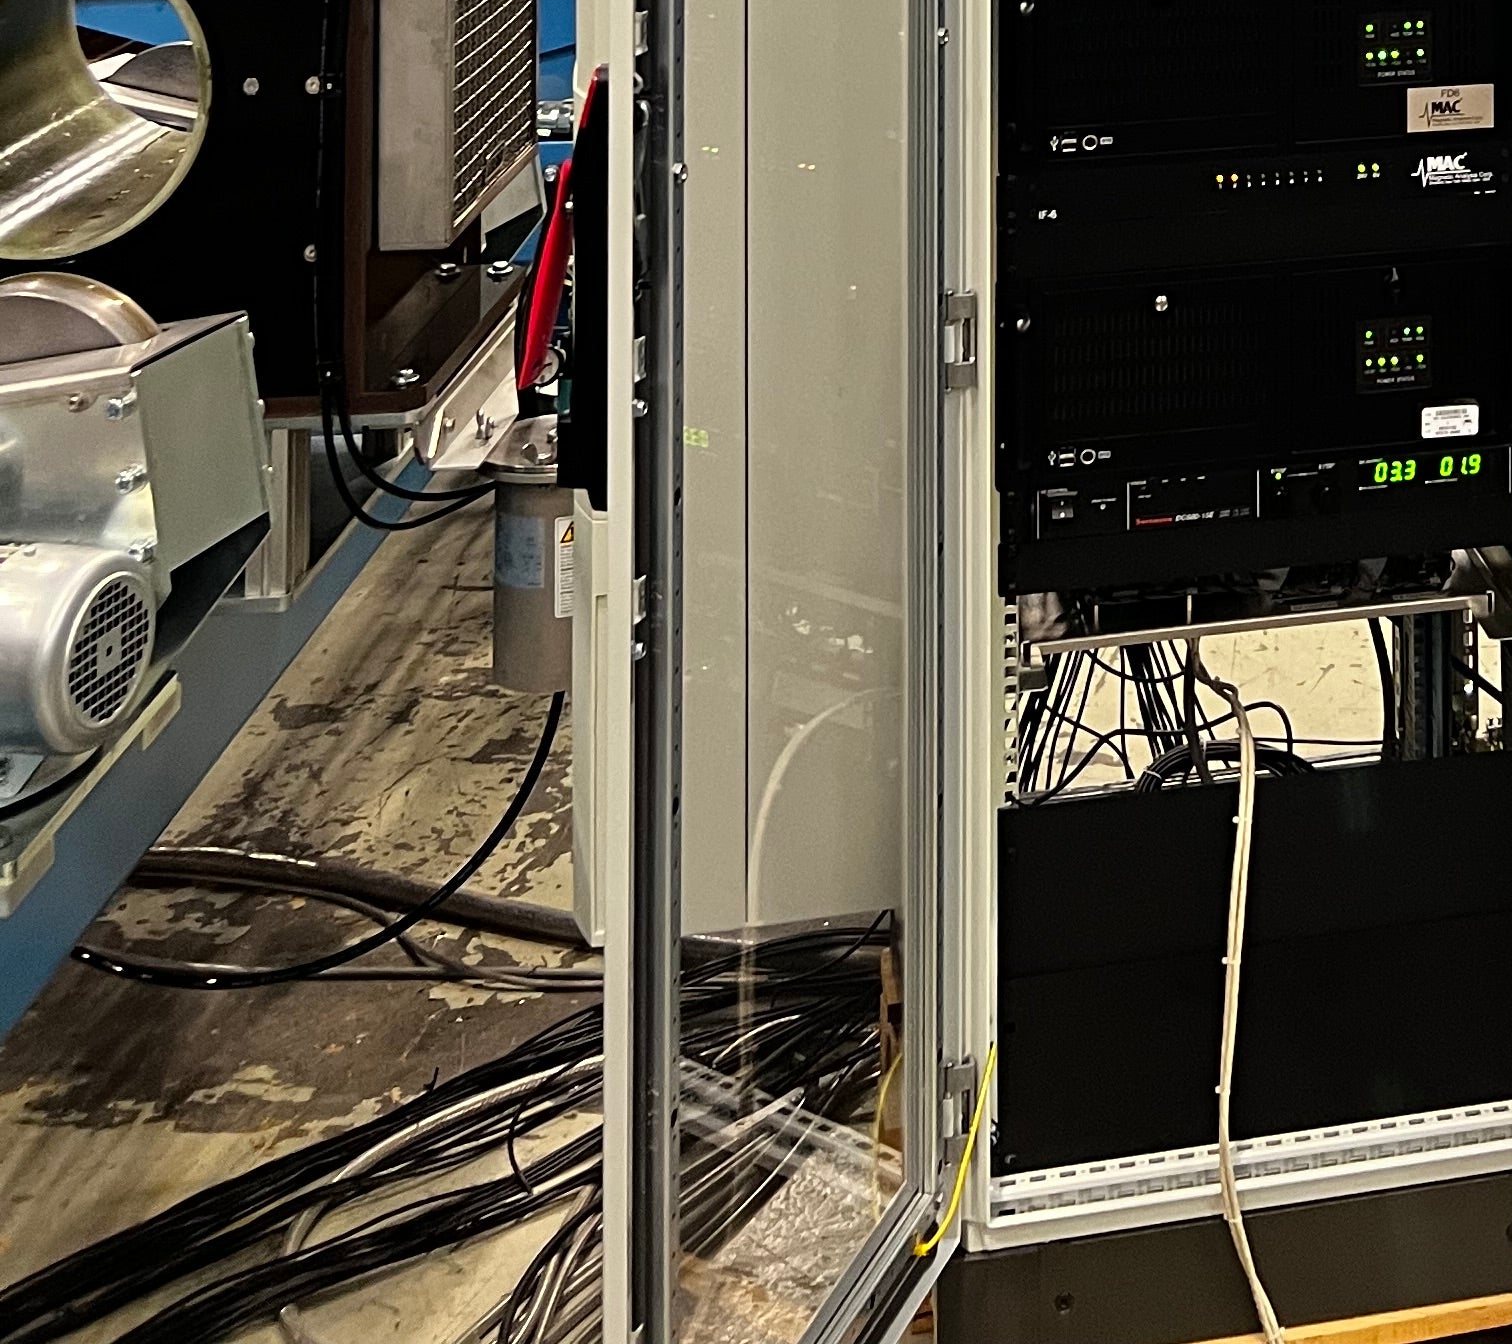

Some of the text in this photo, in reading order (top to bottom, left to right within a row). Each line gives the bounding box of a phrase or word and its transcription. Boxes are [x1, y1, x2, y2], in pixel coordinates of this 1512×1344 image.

[1440, 89, 1460, 98] FD6
[1431, 101, 1461, 114] MAC
[1427, 156, 1466, 171] MAC
